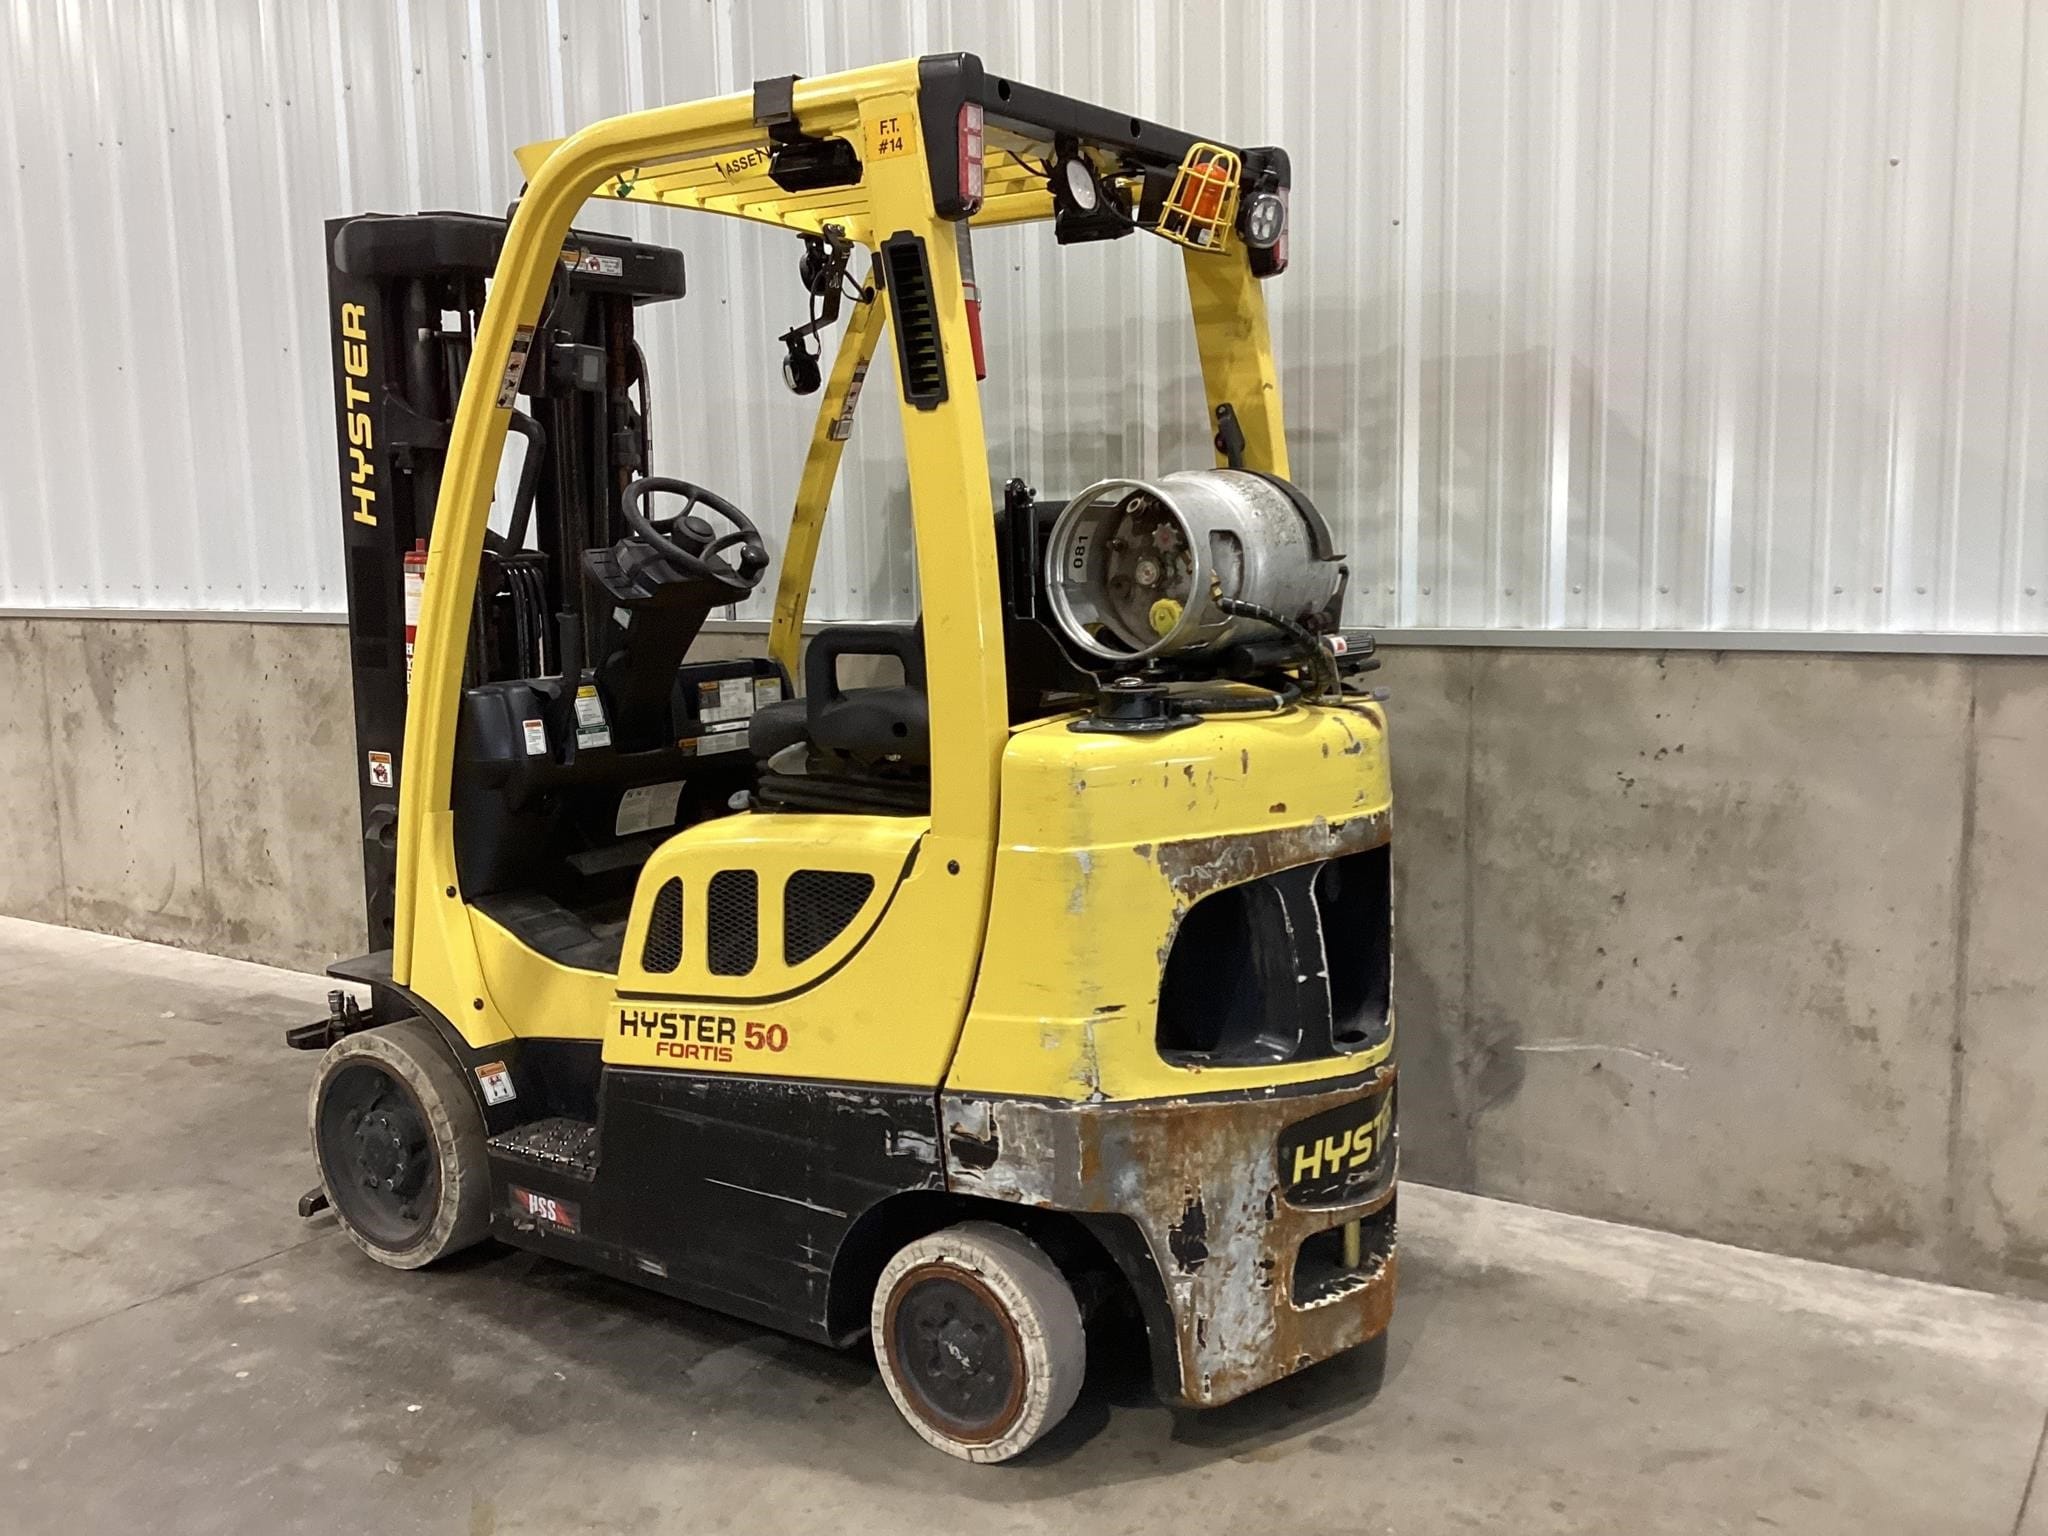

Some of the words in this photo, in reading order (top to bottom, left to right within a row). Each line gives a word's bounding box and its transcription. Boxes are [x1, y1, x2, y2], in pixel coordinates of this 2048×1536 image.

[880, 118, 900, 135] F.T.
[879, 136, 903, 154] #14
[341, 302, 377, 526] HYSTER
[1073, 536, 1088, 568] 081
[620, 1010, 736, 1045] HYSTER
[744, 1022, 788, 1052] 50
[656, 1042, 733, 1062] FORTIS
[1293, 1086, 1393, 1184] HYST
[528, 1193, 557, 1222] HSS
